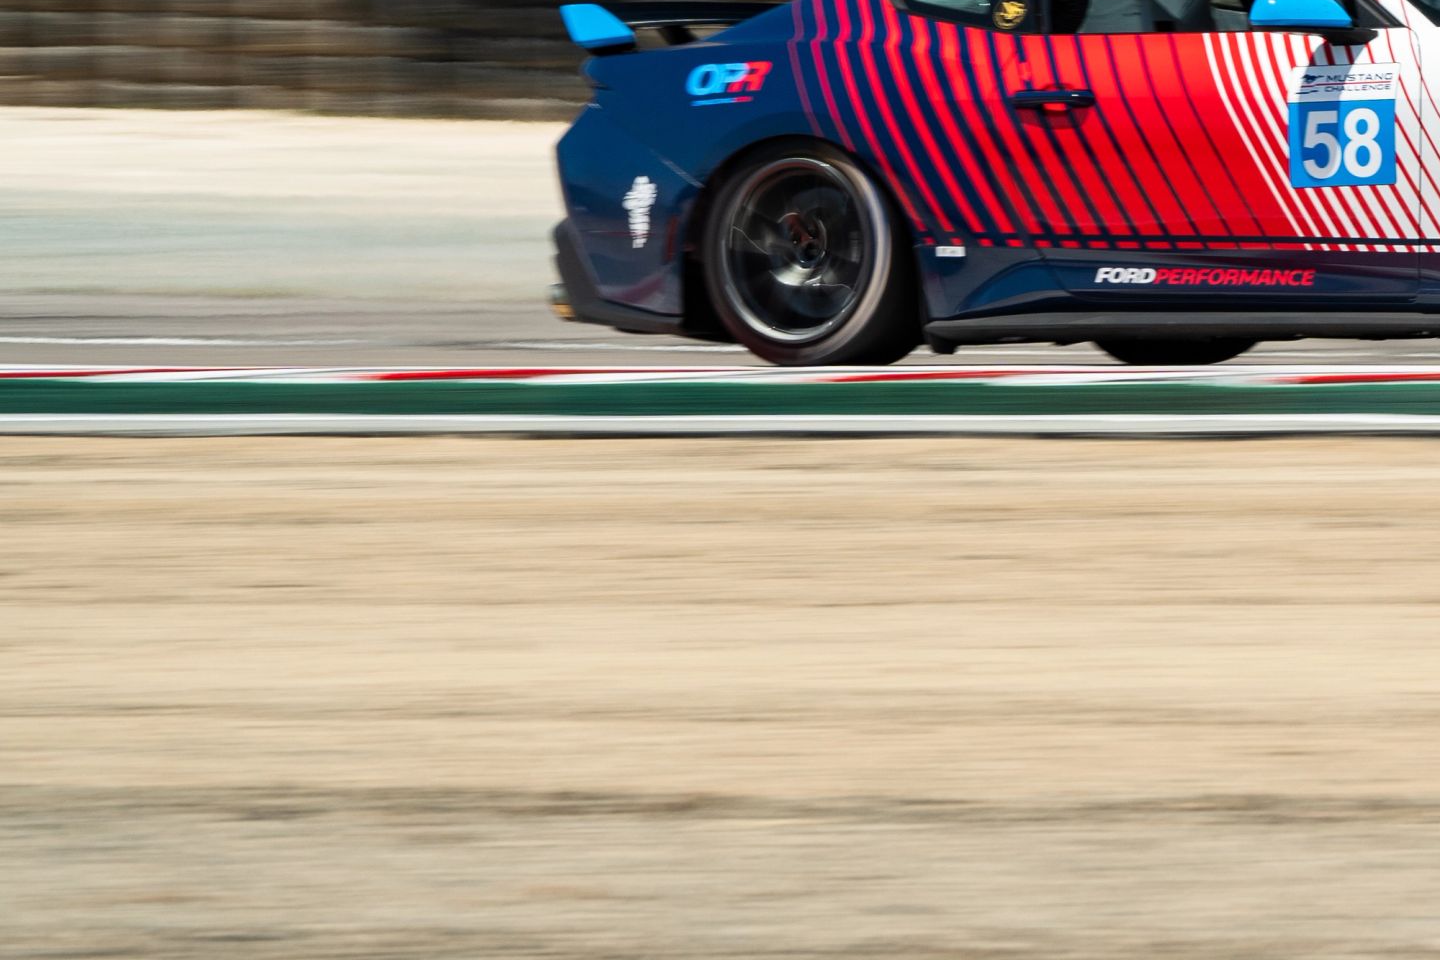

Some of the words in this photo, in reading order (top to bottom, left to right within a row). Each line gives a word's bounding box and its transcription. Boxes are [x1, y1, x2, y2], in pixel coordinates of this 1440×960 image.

[686, 61, 773, 96] OPR
[1324, 83, 1391, 92] CHALLENGE
[1326, 73, 1393, 82] MUSTANG
[1303, 107, 1383, 180] 58
